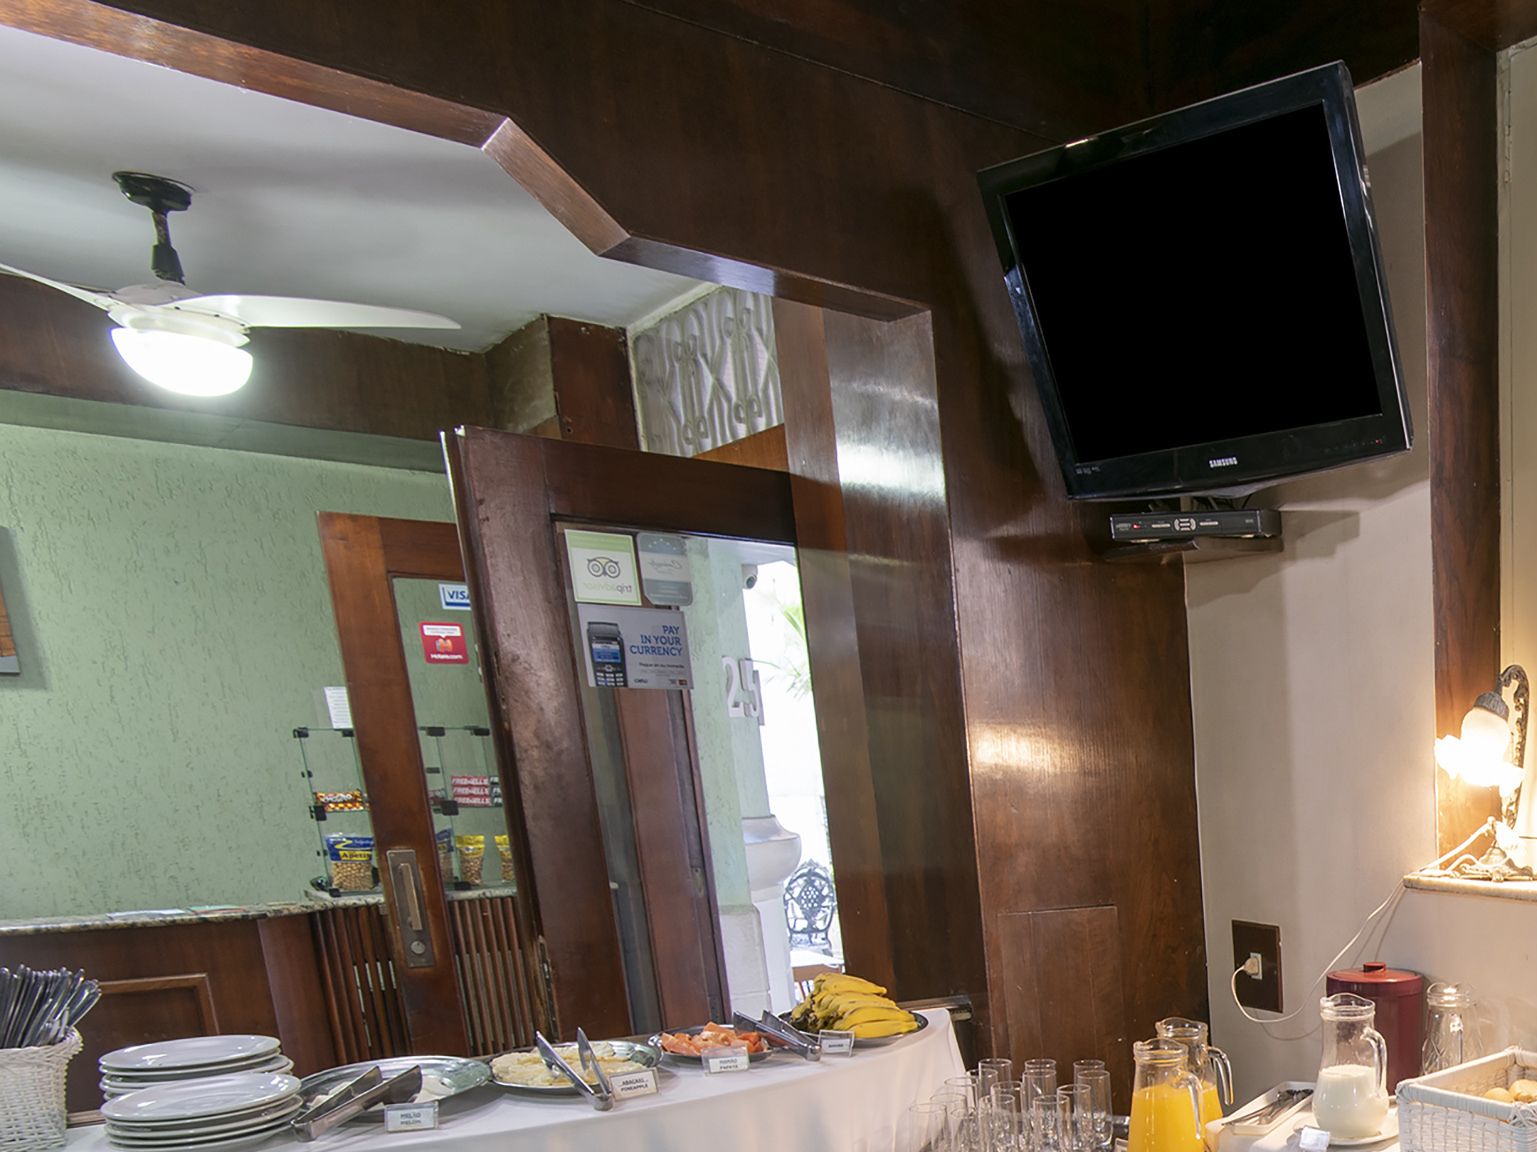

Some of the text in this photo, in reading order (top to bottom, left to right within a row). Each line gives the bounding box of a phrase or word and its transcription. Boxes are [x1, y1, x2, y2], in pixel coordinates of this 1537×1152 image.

[1209, 457, 1238, 468] SAMSUNG
[662, 625, 680, 635] PAY
[640, 634, 682, 646] IN YOUR
[630, 645, 683, 656] CURRENCY
